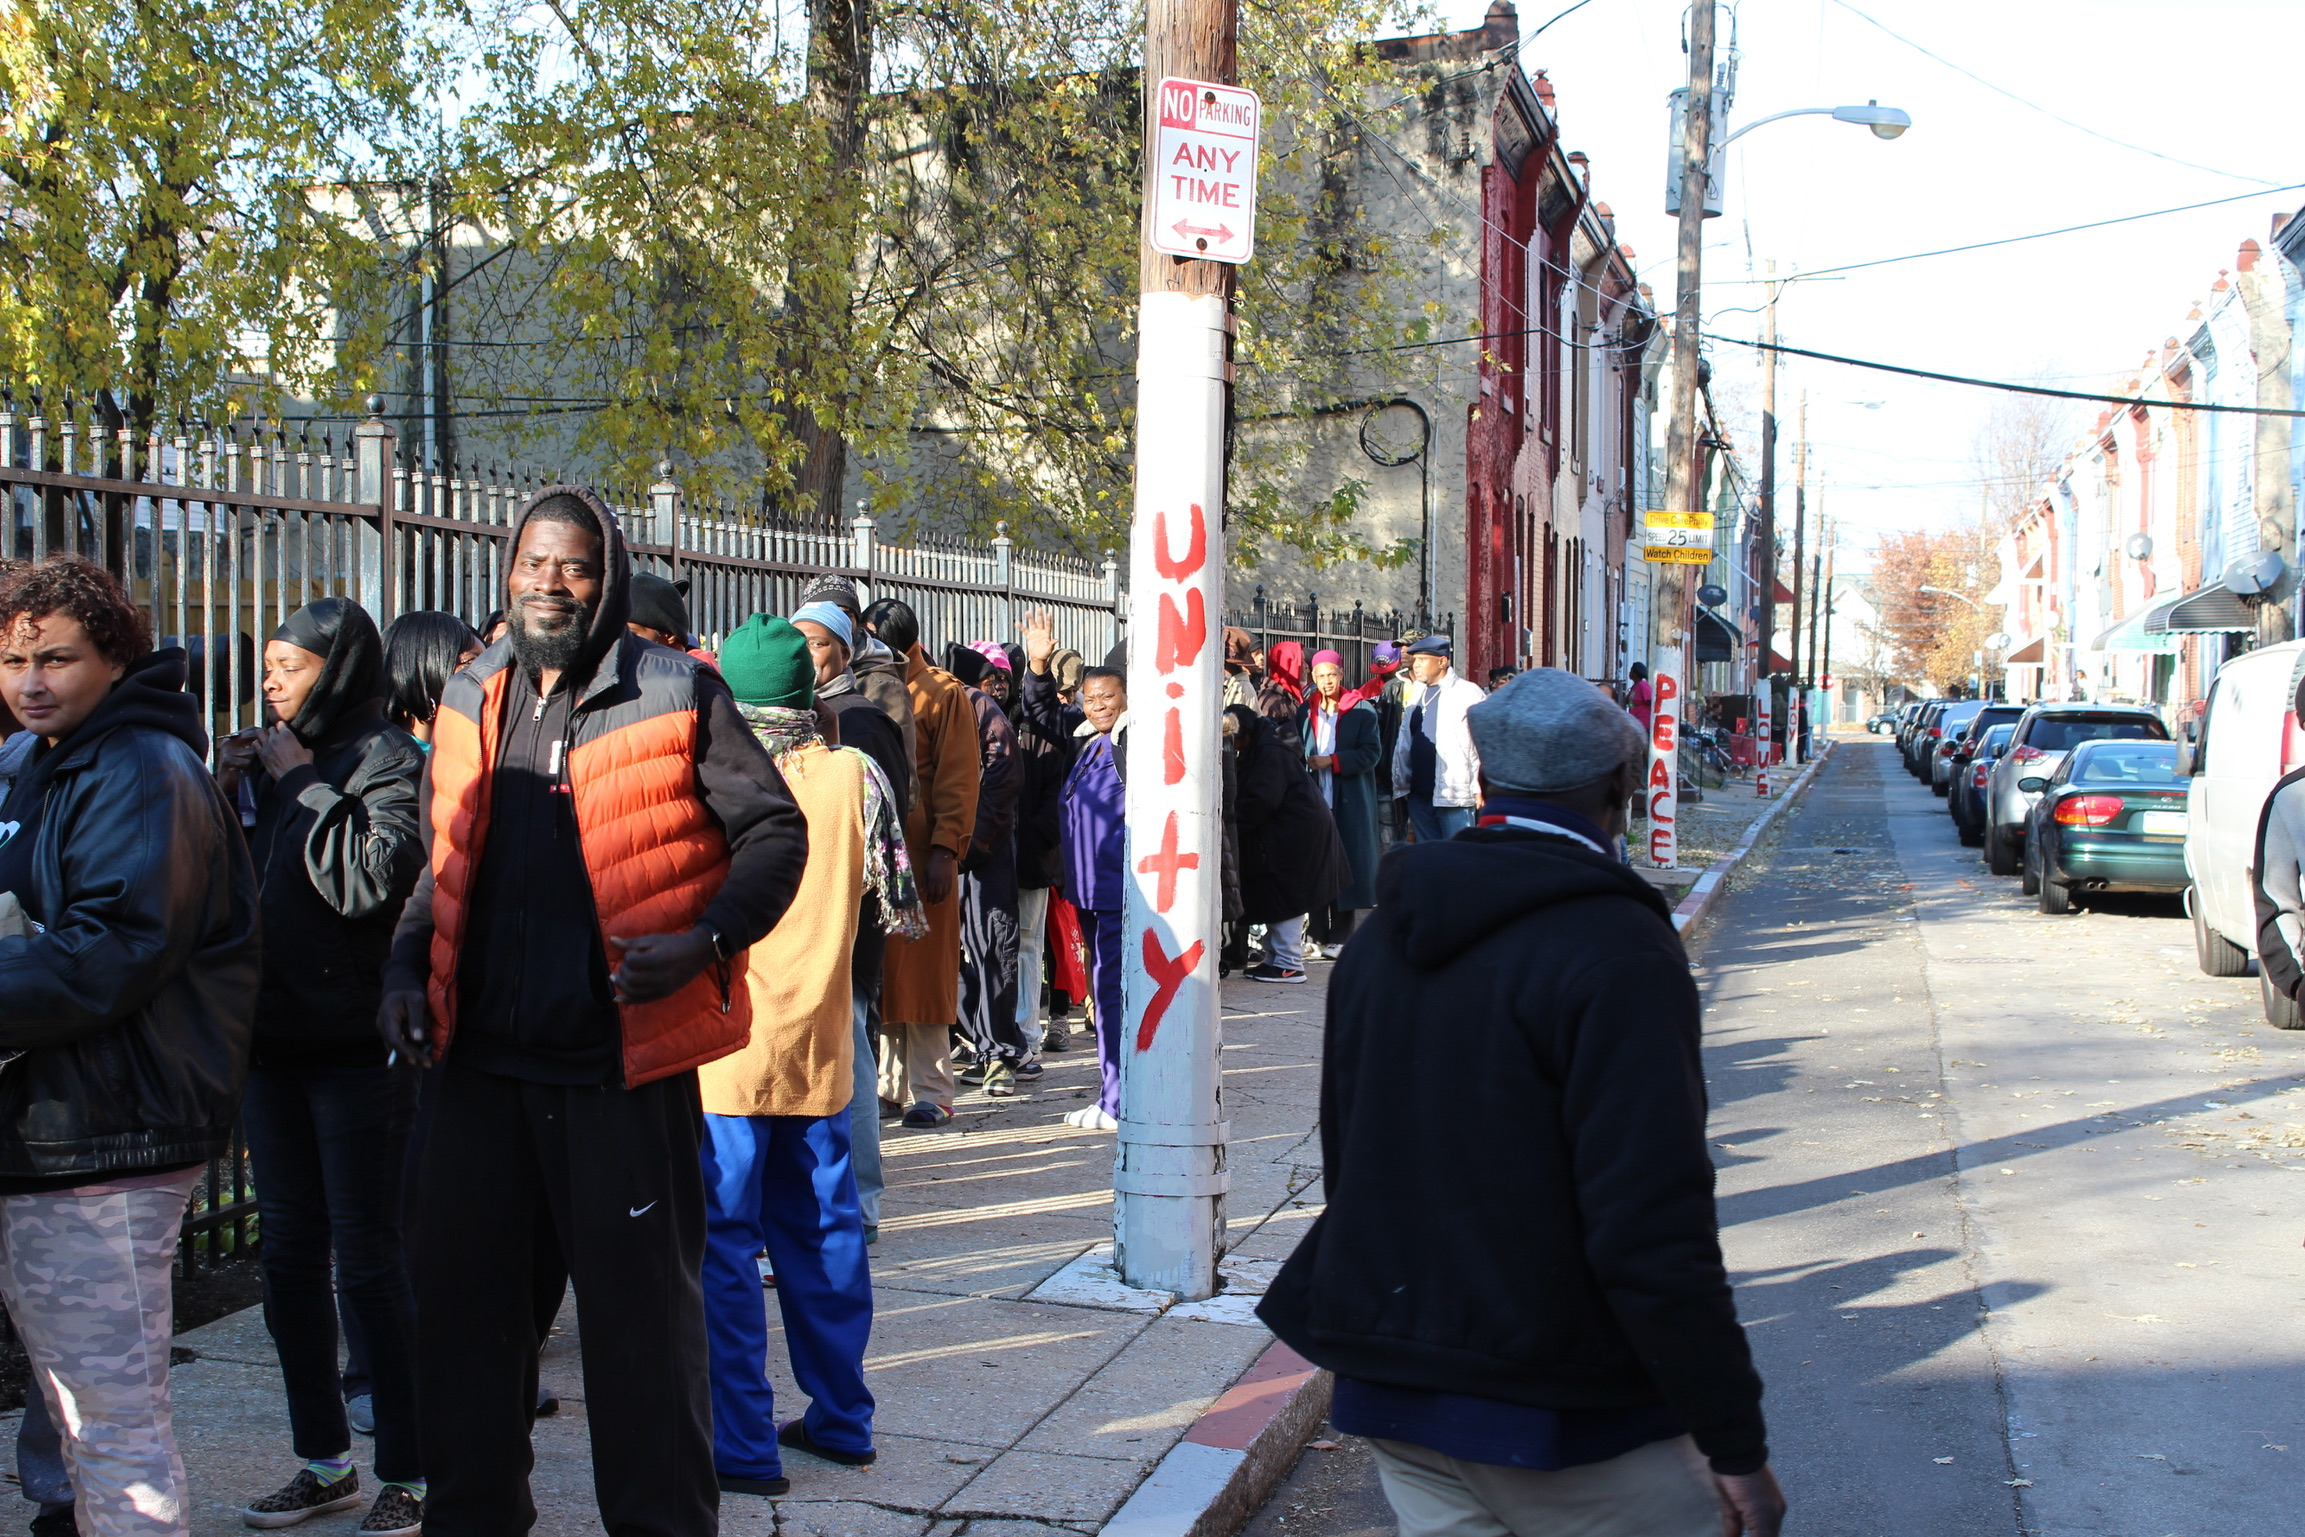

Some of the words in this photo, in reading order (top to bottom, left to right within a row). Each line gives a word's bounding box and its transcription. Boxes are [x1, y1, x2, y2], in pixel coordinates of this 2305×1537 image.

[1163, 87, 1194, 122] NO
[1199, 99, 1251, 127] PARKING
[1172, 142, 1241, 174] ANY
[1171, 175, 1240, 209] TIME
[1650, 515, 1669, 523] Drive
[1648, 533, 1666, 541] SPEED
[1668, 529, 1687, 546] 25
[1689, 535, 1708, 544] LIMIT
[1646, 548, 1672, 558] Watch
[1673, 550, 1709, 560] Children
[1650, 673, 1677, 863] PEACE
